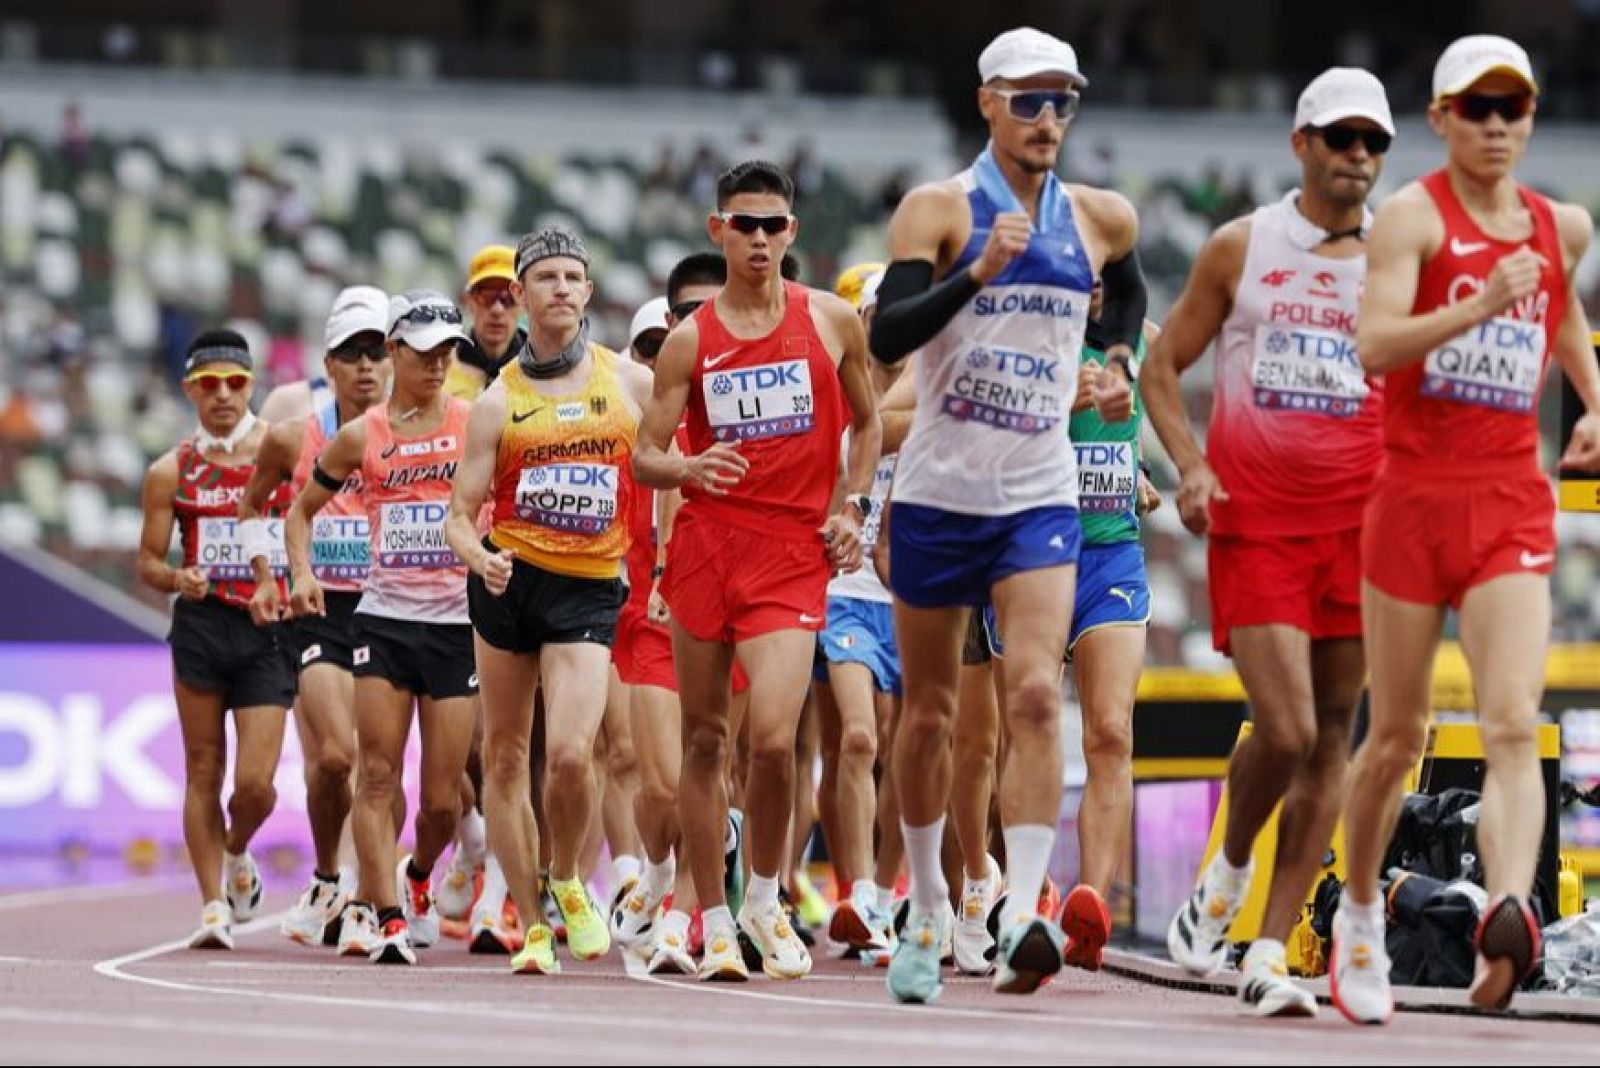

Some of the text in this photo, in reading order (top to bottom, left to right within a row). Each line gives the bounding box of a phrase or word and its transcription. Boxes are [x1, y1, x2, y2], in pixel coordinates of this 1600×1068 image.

[974, 293, 1072, 317] SLOVAKIA
[1448, 273, 1549, 324] CNA
[1290, 331, 1357, 367] TDK
[1478, 323, 1537, 352] TDK
[732, 364, 801, 392] TDK
[993, 350, 1055, 383] TDK
[1436, 347, 1517, 382] QIAN
[953, 371, 1035, 410] ČERNÝ
[738, 396, 762, 420] LI
[524, 437, 618, 463] GERMANY
[1074, 445, 1126, 465] TDK
[381, 461, 458, 489] JAPAN
[547, 466, 611, 488] TDK
[405, 503, 449, 523] TD
[522, 487, 593, 514] KÖPP
[222, 521, 279, 538] TK
[203, 544, 243, 562] ORT
